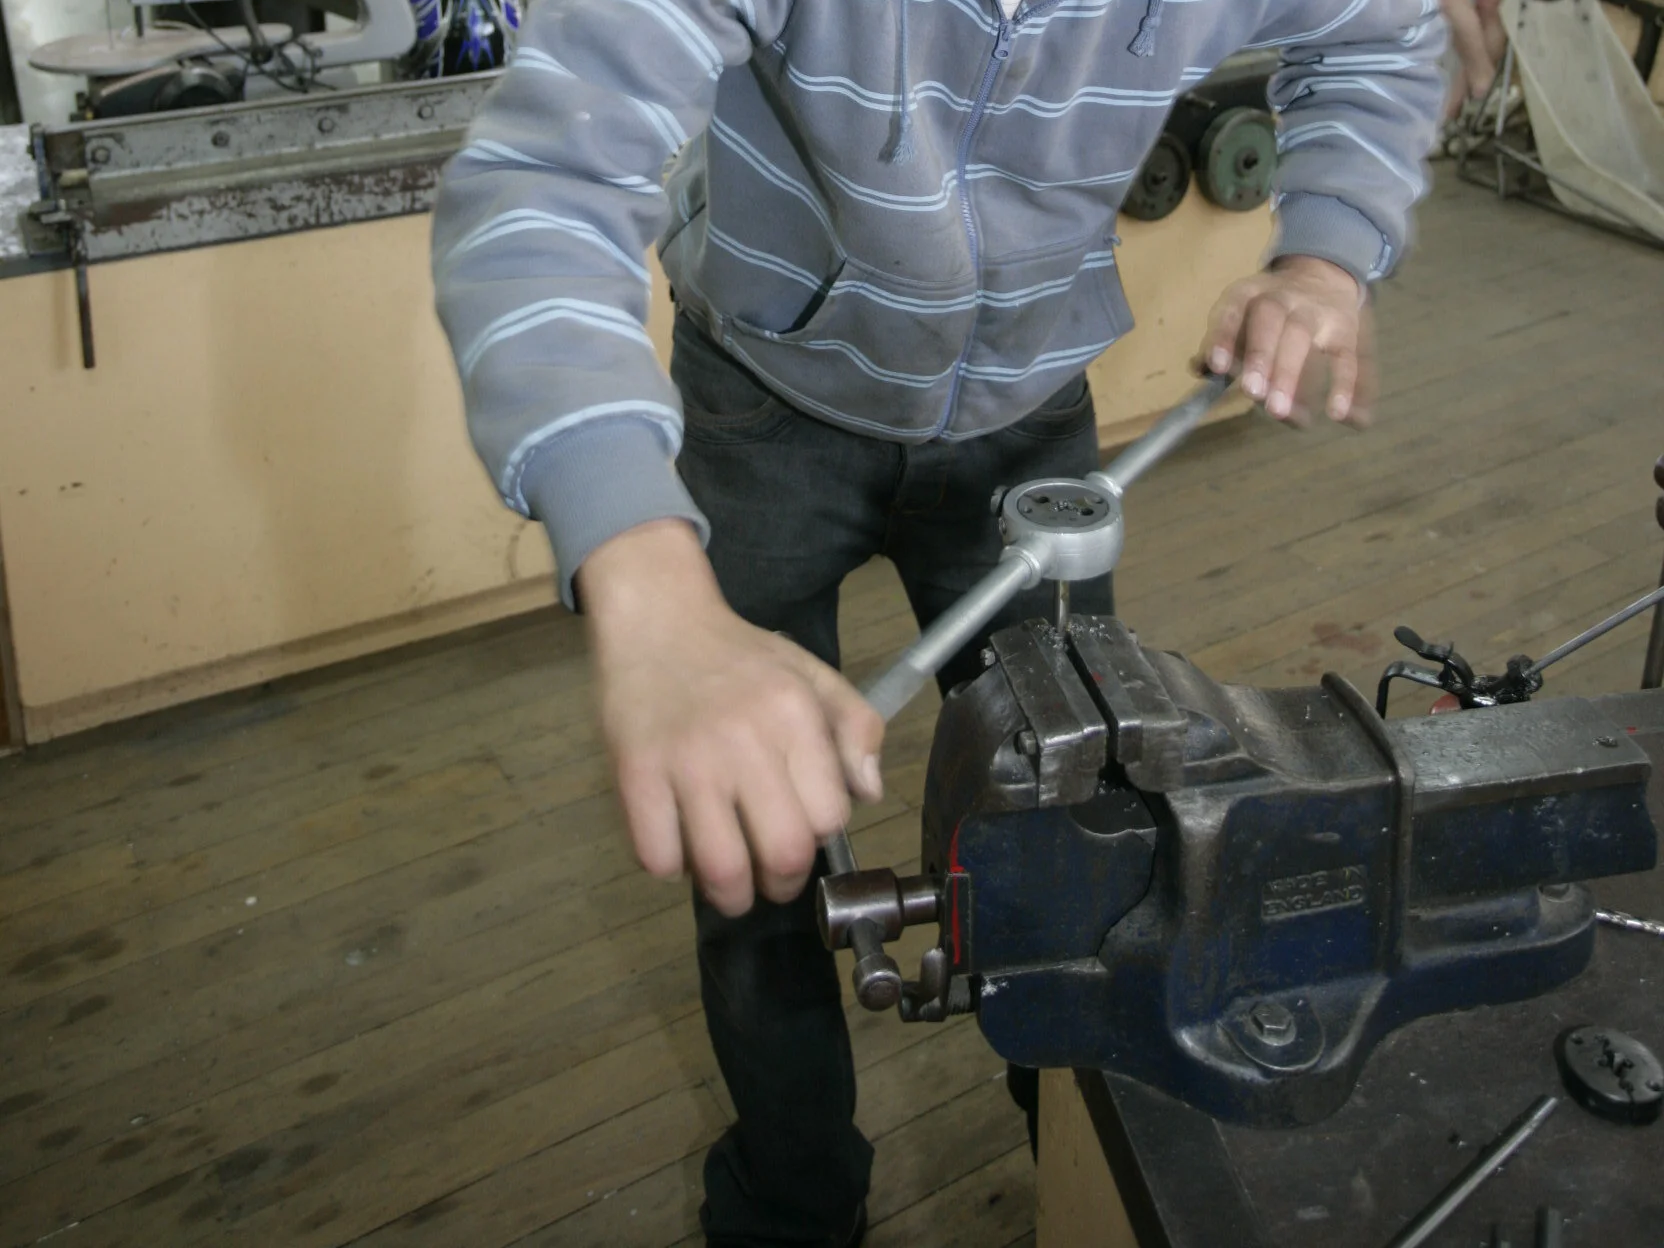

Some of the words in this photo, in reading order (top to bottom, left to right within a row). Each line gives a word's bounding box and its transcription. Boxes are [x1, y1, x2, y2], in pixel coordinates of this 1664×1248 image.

[1269, 870, 1328, 892] MADE
[1343, 864, 1367, 884] IN
[1262, 884, 1364, 914] ENGLAND
